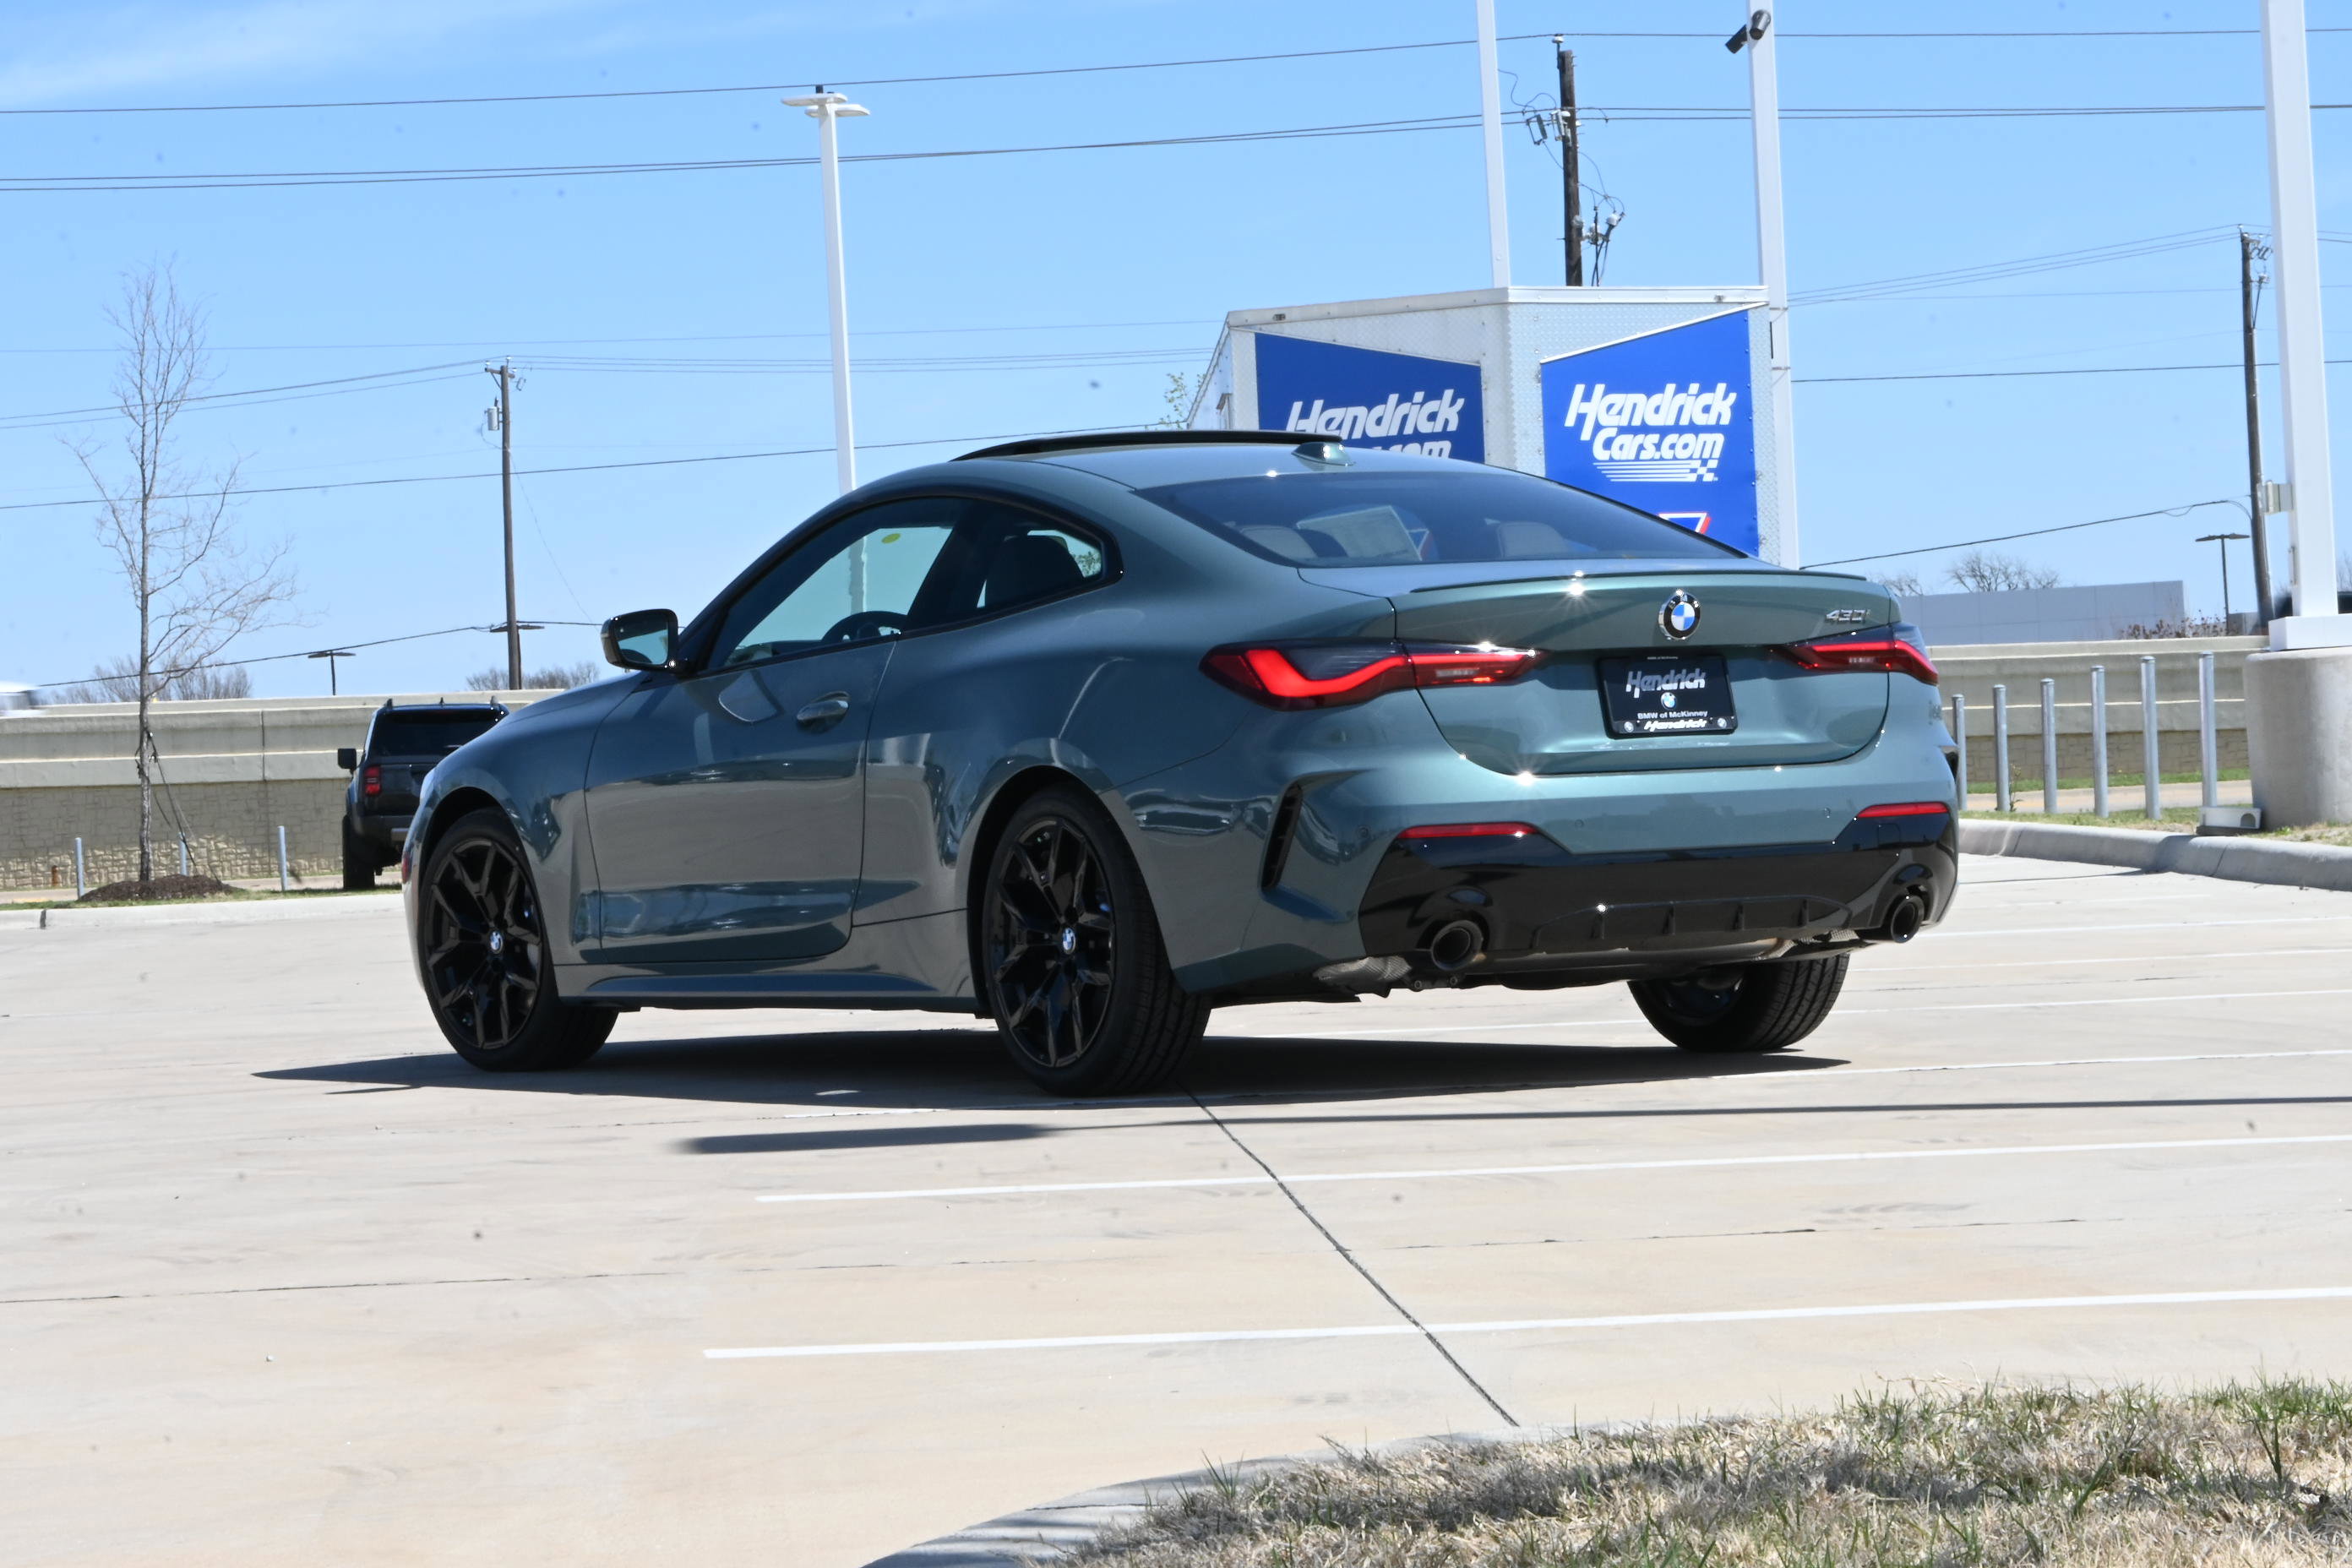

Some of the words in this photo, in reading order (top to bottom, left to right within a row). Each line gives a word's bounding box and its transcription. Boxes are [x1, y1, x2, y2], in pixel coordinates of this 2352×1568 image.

[1285, 389, 1466, 440] Hendrick
[1564, 383, 1737, 441] Hendrick
[1592, 427, 1725, 461] Cars.com
[1625, 668, 1707, 699] Hendrick
[1659, 711, 1668, 720] of
